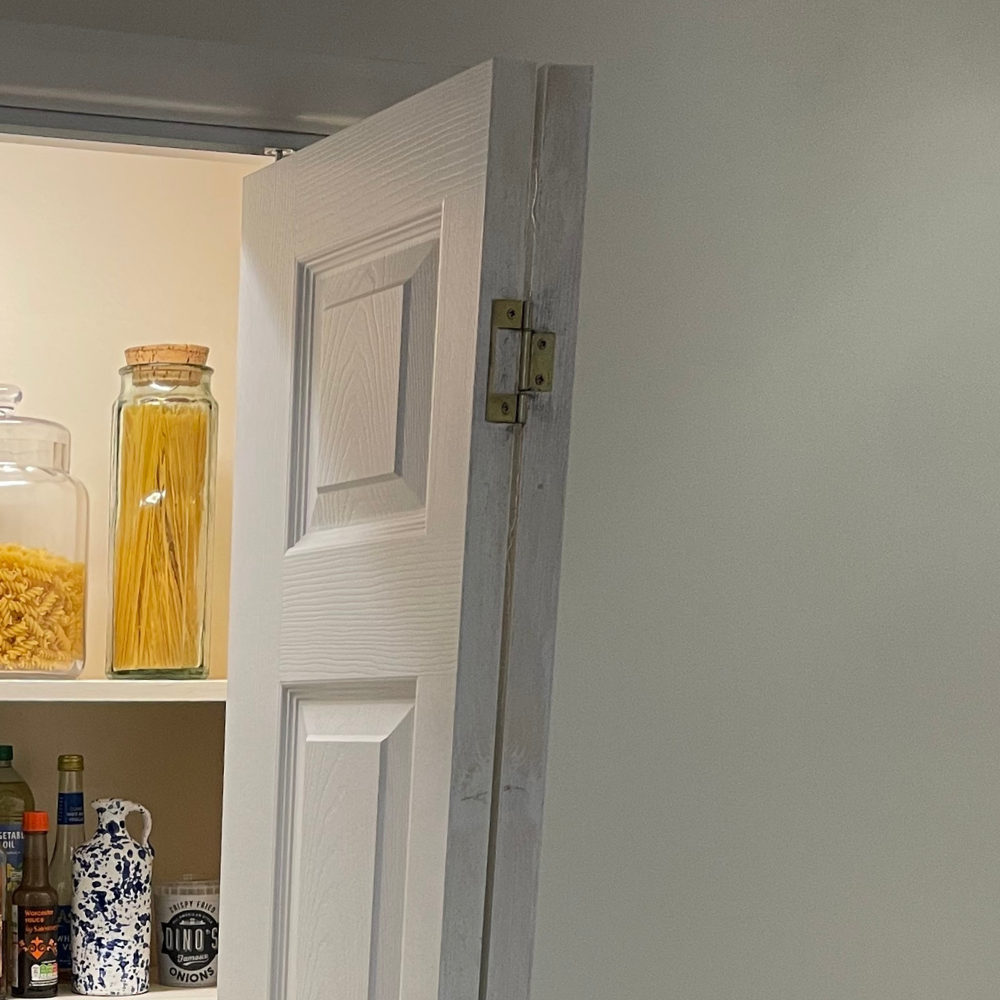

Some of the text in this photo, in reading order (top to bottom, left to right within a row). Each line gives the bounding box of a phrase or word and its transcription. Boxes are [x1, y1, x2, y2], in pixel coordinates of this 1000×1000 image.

[2, 841, 15, 849] OIL
[24, 909, 55, 917] Worcester
[168, 901, 217, 914] CRISPY FRIED
[165, 927, 218, 952] DINO'S
[169, 966, 215, 983] ONIONS
